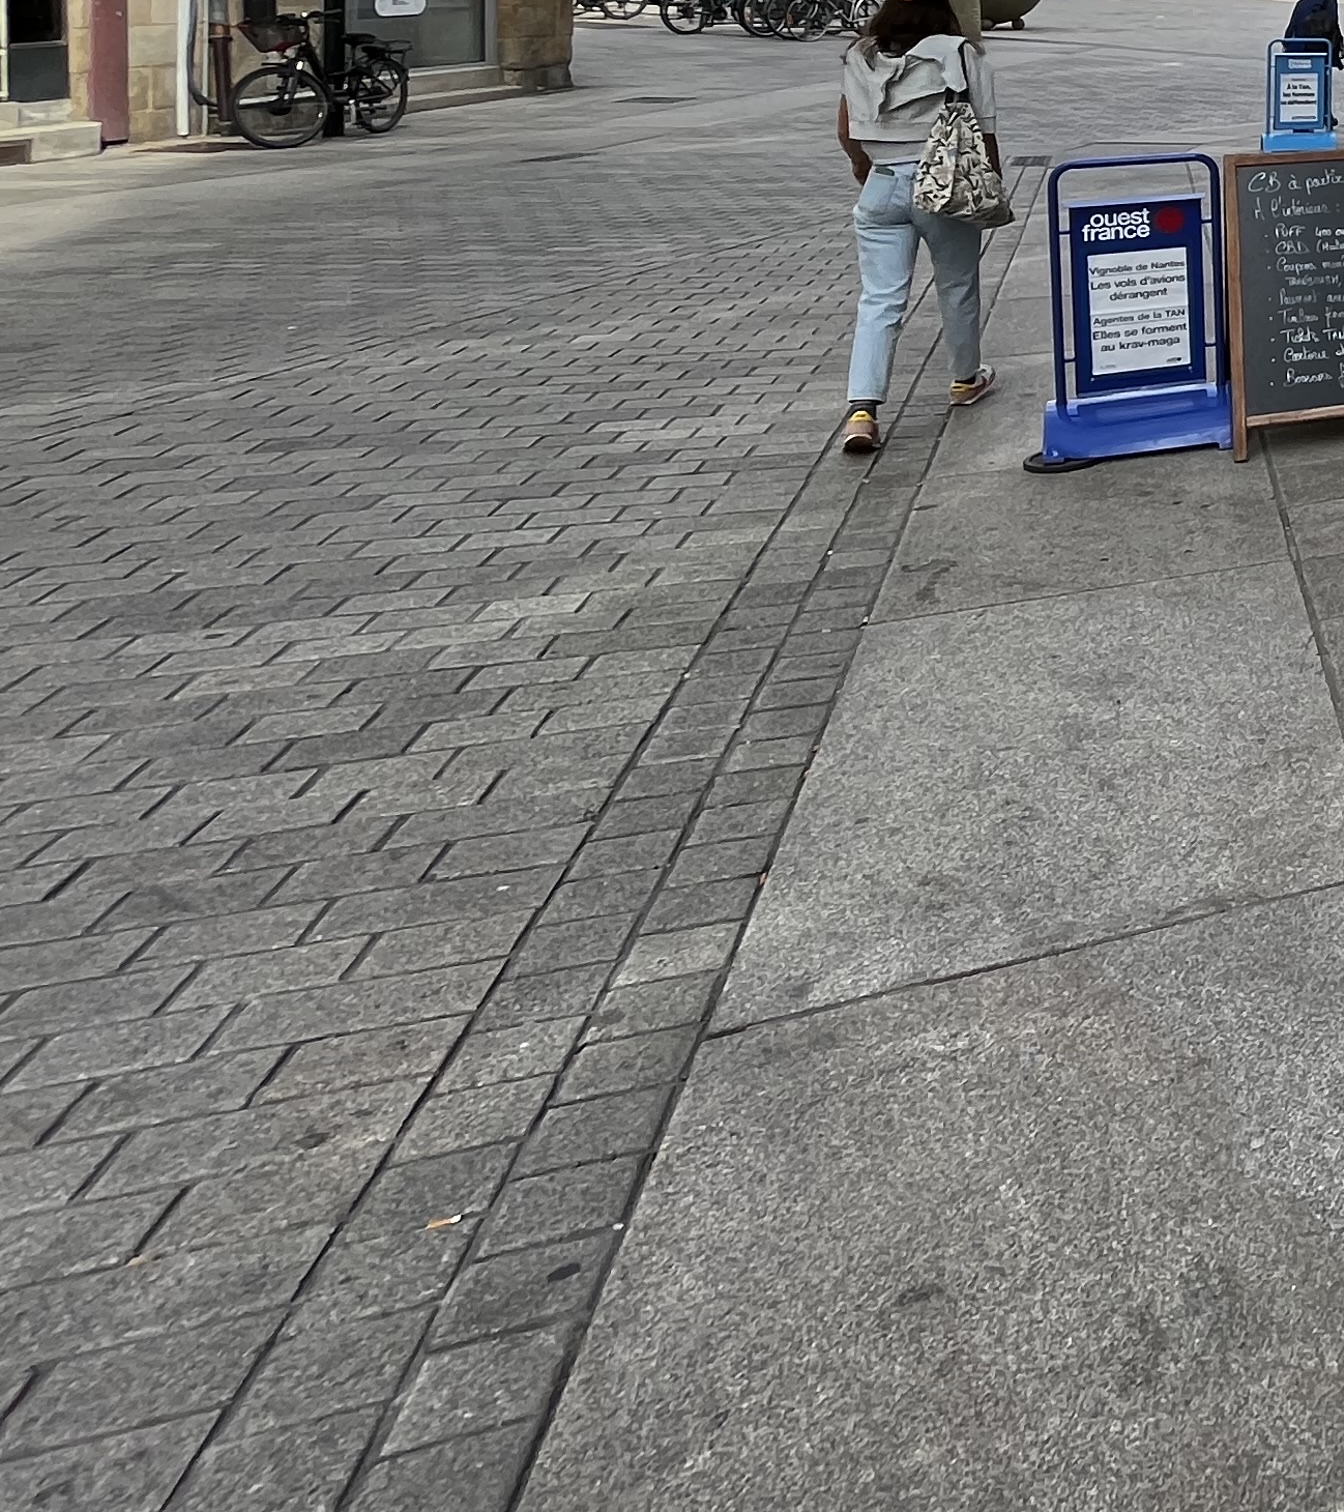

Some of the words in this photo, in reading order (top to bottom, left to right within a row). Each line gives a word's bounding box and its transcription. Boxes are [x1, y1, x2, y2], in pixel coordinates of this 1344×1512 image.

[1248, 171, 1281, 193] CB
[1288, 174, 1302, 190] à
[1089, 208, 1150, 228] ouest
[1081, 224, 1151, 242] france
[1275, 223, 1306, 238] PUFF
[1275, 240, 1310, 255] CBD
[1089, 265, 1133, 277] Vignoble
[1135, 263, 1148, 271] de
[1151, 260, 1185, 270] Nantes
[1090, 280, 1111, 291] Les
[1114, 277, 1137, 288] vols
[1139, 274, 1186, 287] d'avions
[1109, 287, 1168, 301] dérangent
[1093, 316, 1135, 328] Agentes
[1138, 313, 1150, 321] de
[1153, 311, 1162, 319] la
[1165, 309, 1186, 318] TAN
[1093, 330, 1121, 341] Elles
[1124, 328, 1138, 338] se
[1142, 322, 1187, 335] forment
[1100, 342, 1116, 352] au
[1119, 336, 1181, 350] krav-maga
